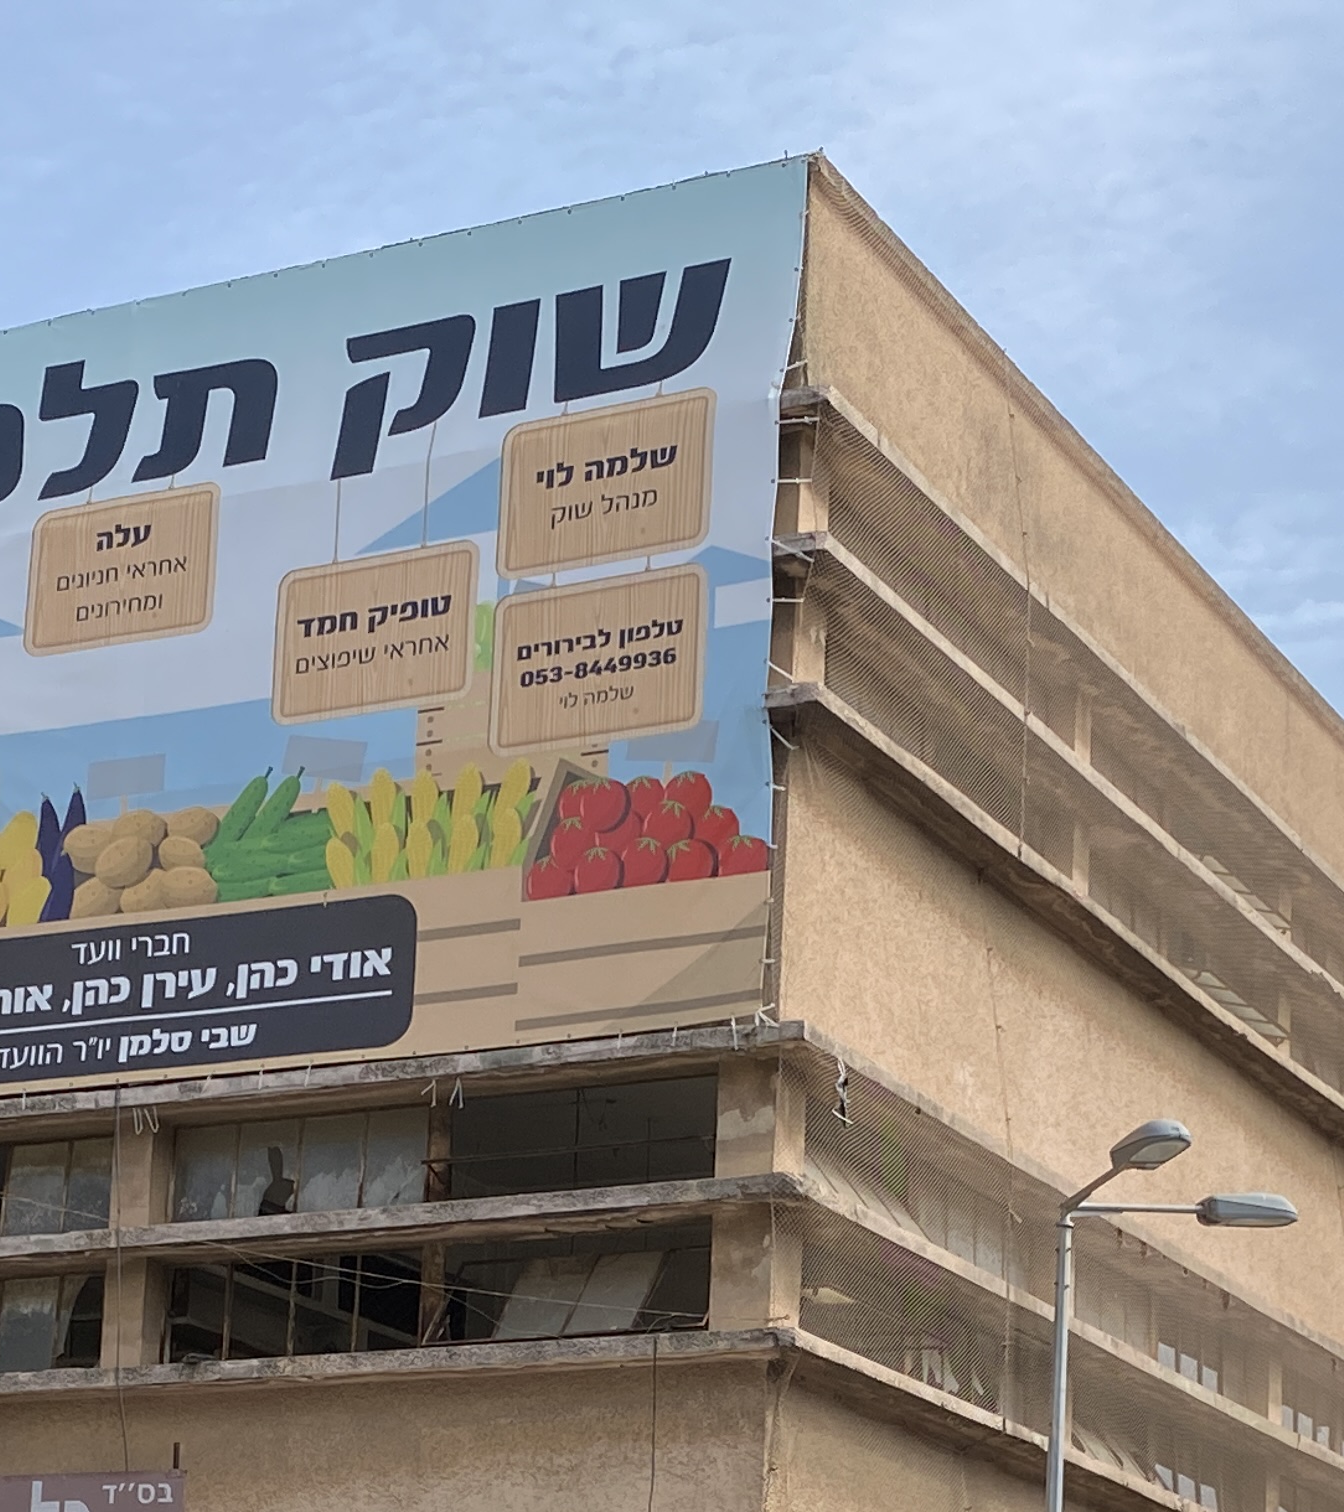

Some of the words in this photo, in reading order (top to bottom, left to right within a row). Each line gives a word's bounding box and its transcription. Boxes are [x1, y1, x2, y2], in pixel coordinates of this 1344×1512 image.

[330, 257, 731, 480] שוק
[536, 461, 574, 489] לוי
[584, 444, 678, 482] שלמה
[551, 499, 592, 529] שוק
[601, 488, 658, 514] מנהל
[96, 523, 152, 552] עלה
[56, 566, 118, 592] חניונים
[127, 556, 187, 580] אחראי
[76, 593, 163, 622] ומחירונים
[367, 595, 452, 634] טופיק
[297, 611, 358, 638] חמד
[618, 618, 683, 648] טלפון
[384, 634, 449, 660] אחראי
[517, 628, 611, 662] לבירורים
[295, 646, 376, 675] שיפוצים
[520, 647, 677, 688] 053-8449936
[559, 692, 579, 709] לוי
[583, 684, 634, 705] שלמה
[70, 939, 121, 966] וועד
[131, 931, 190, 958] חברי
[226, 957, 298, 999] כהן,
[309, 945, 393, 982] אודי
[62, 976, 131, 1016] כהן,
[140, 965, 216, 1008] עירן
[118, 1029, 190, 1063] סלמן
[200, 1022, 257, 1051] שבי
